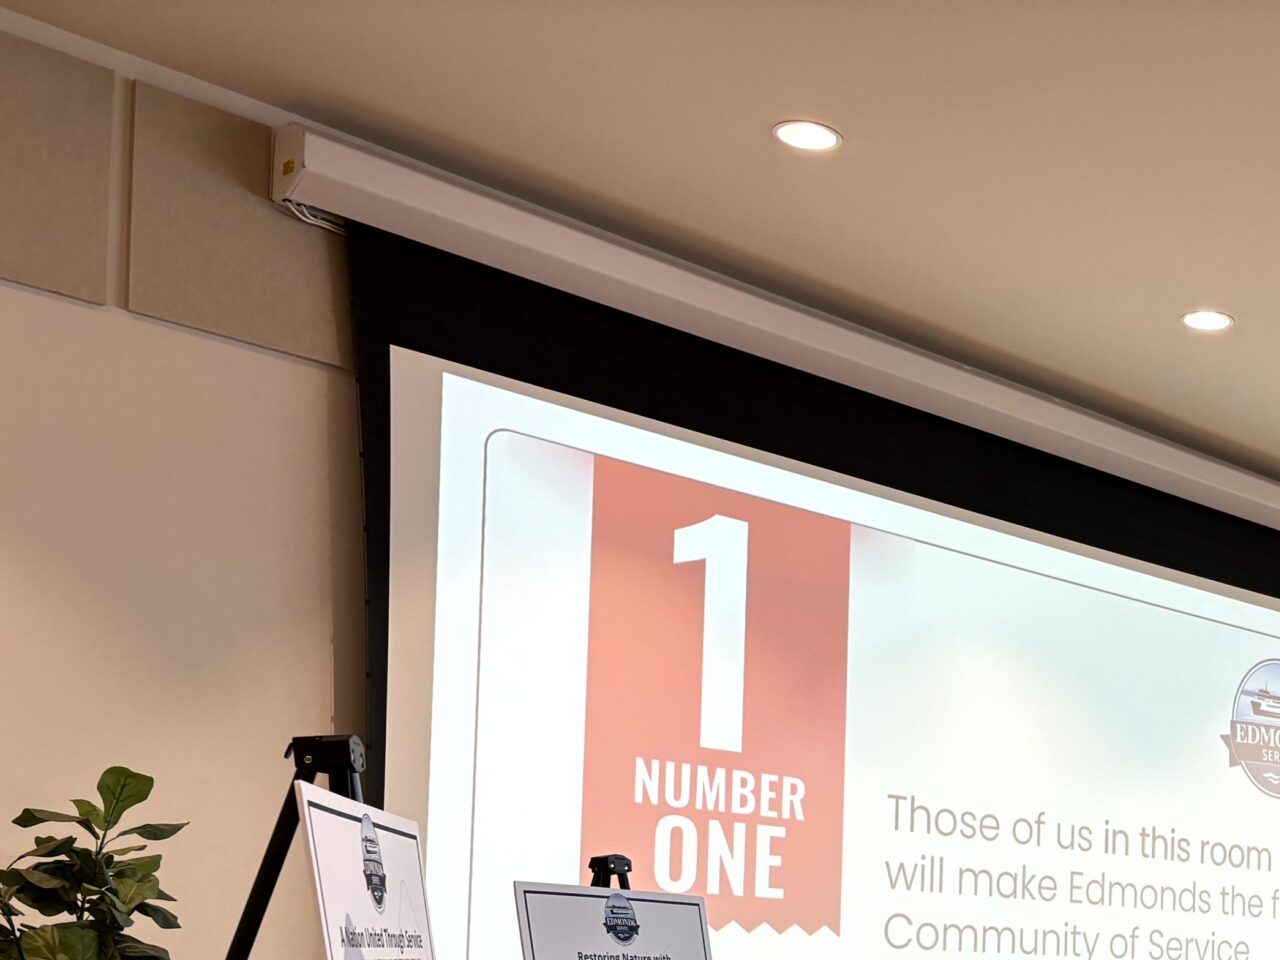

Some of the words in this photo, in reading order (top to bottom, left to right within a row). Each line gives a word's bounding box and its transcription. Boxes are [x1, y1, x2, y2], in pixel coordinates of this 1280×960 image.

[673, 514, 748, 753] 1
[634, 757, 806, 821] NUMBER
[653, 815, 786, 899] ONE
[888, 794, 1000, 842] Those
[1013, 812, 1045, 846] of
[1057, 823, 1092, 851] us
[1105, 820, 1129, 856] in
[1139, 826, 1190, 862] this
[1201, 840, 1271, 871] room
[885, 854, 943, 893] will
[959, 864, 1057, 902] make
[1070, 871, 1211, 914] Edmonds
[1220, 885, 1263, 918] the
[340, 926, 346, 947] A
[345, 926, 364, 948] Nation
[364, 928, 383, 949] United
[384, 929, 404, 954] Through
[405, 930, 423, 949] Service
[607, 918, 636, 927] EDMONDS
[1110, 926, 1139, 959] of
